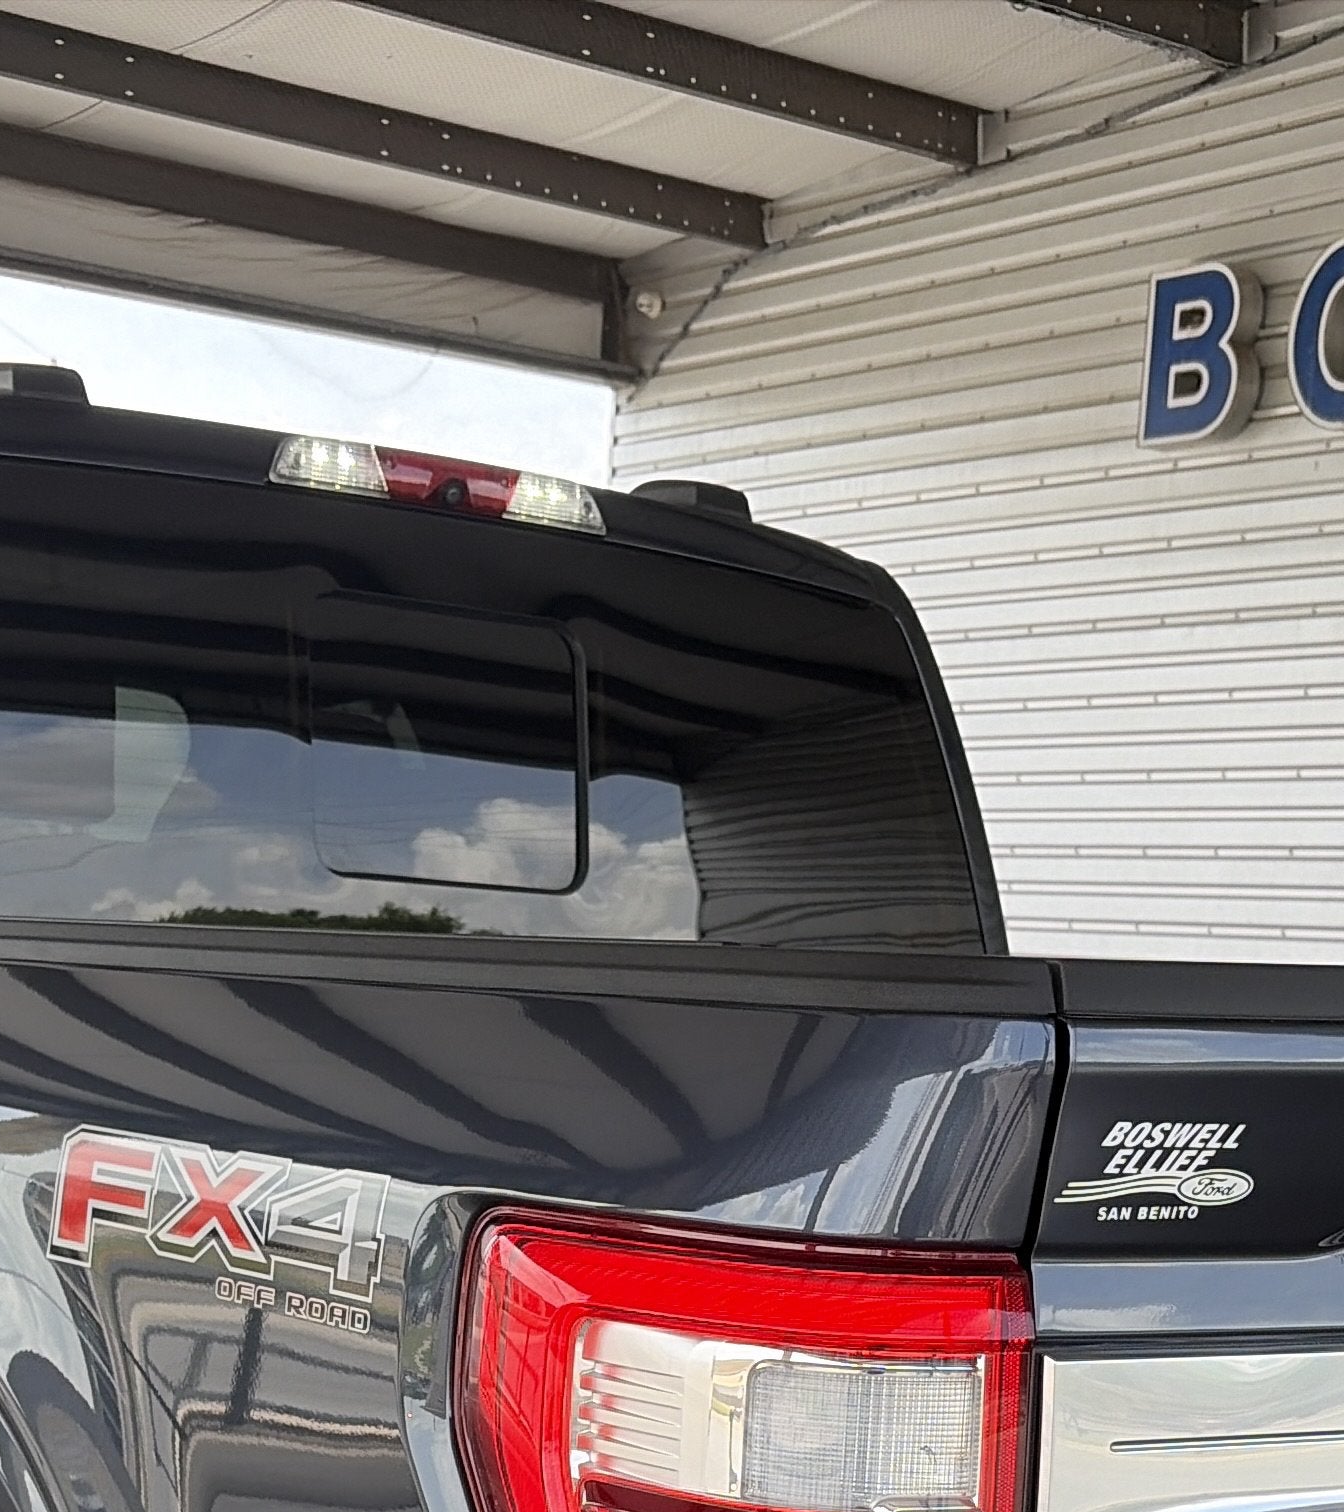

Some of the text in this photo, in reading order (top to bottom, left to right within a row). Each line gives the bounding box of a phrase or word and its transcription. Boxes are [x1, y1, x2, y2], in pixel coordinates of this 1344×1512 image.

[1100, 1121, 1247, 1149] BOSWELL
[1103, 1148, 1217, 1174] ELLIFF
[1192, 1177, 1235, 1197] Ford
[46, 1123, 392, 1304] FX4
[1096, 1205, 1199, 1221] SAN BENITO
[215, 1277, 372, 1335] OFF ROAD
